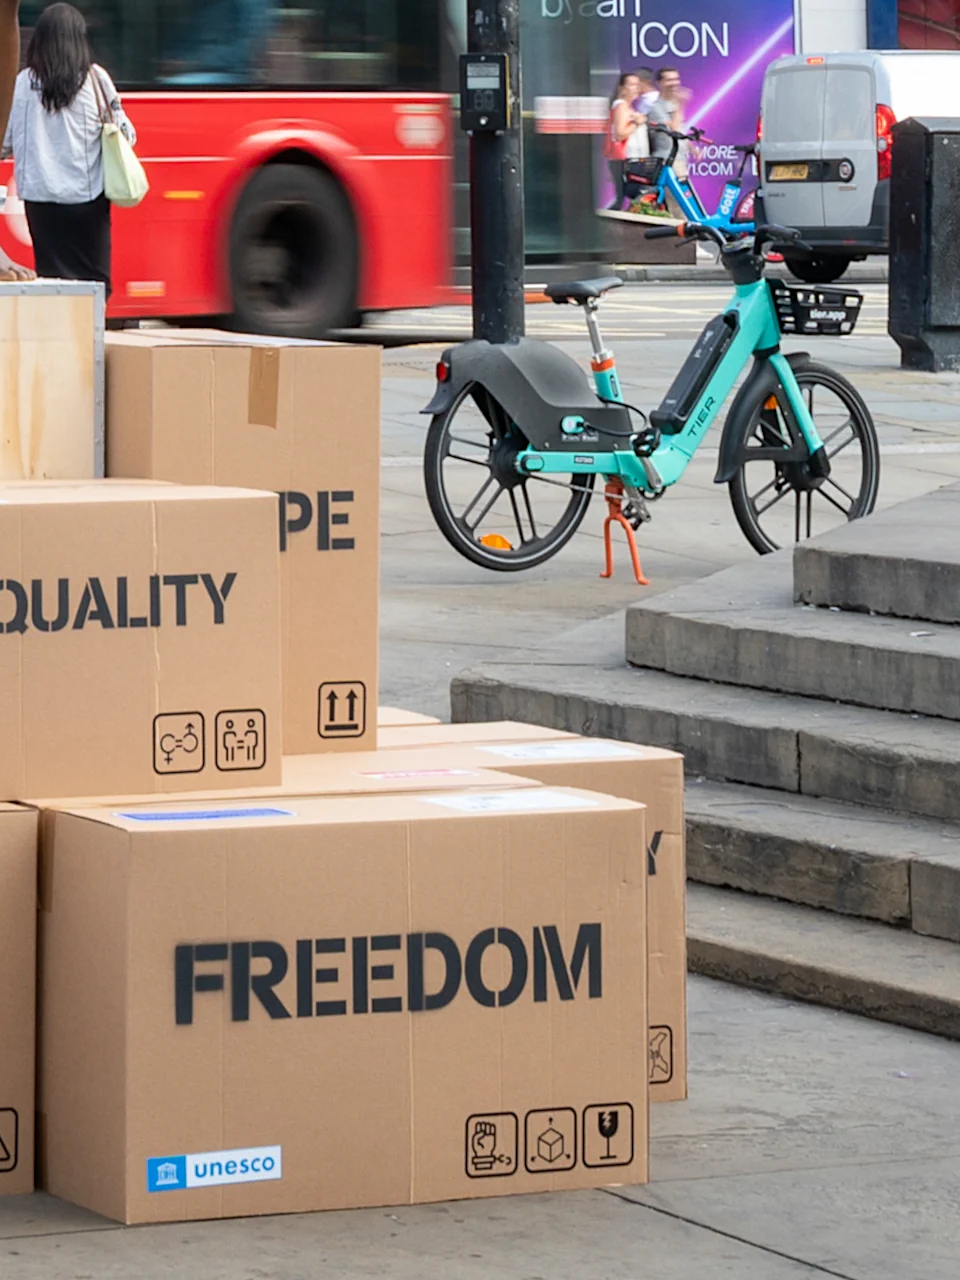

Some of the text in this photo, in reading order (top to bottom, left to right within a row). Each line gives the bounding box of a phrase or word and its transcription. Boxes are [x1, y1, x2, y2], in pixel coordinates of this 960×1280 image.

[631, 22, 729, 58] ICON
[687, 396, 716, 437] TIER
[280, 491, 356, 552] PE
[174, 922, 603, 1025] FREEDOM
[194, 1154, 276, 1183] unesco
